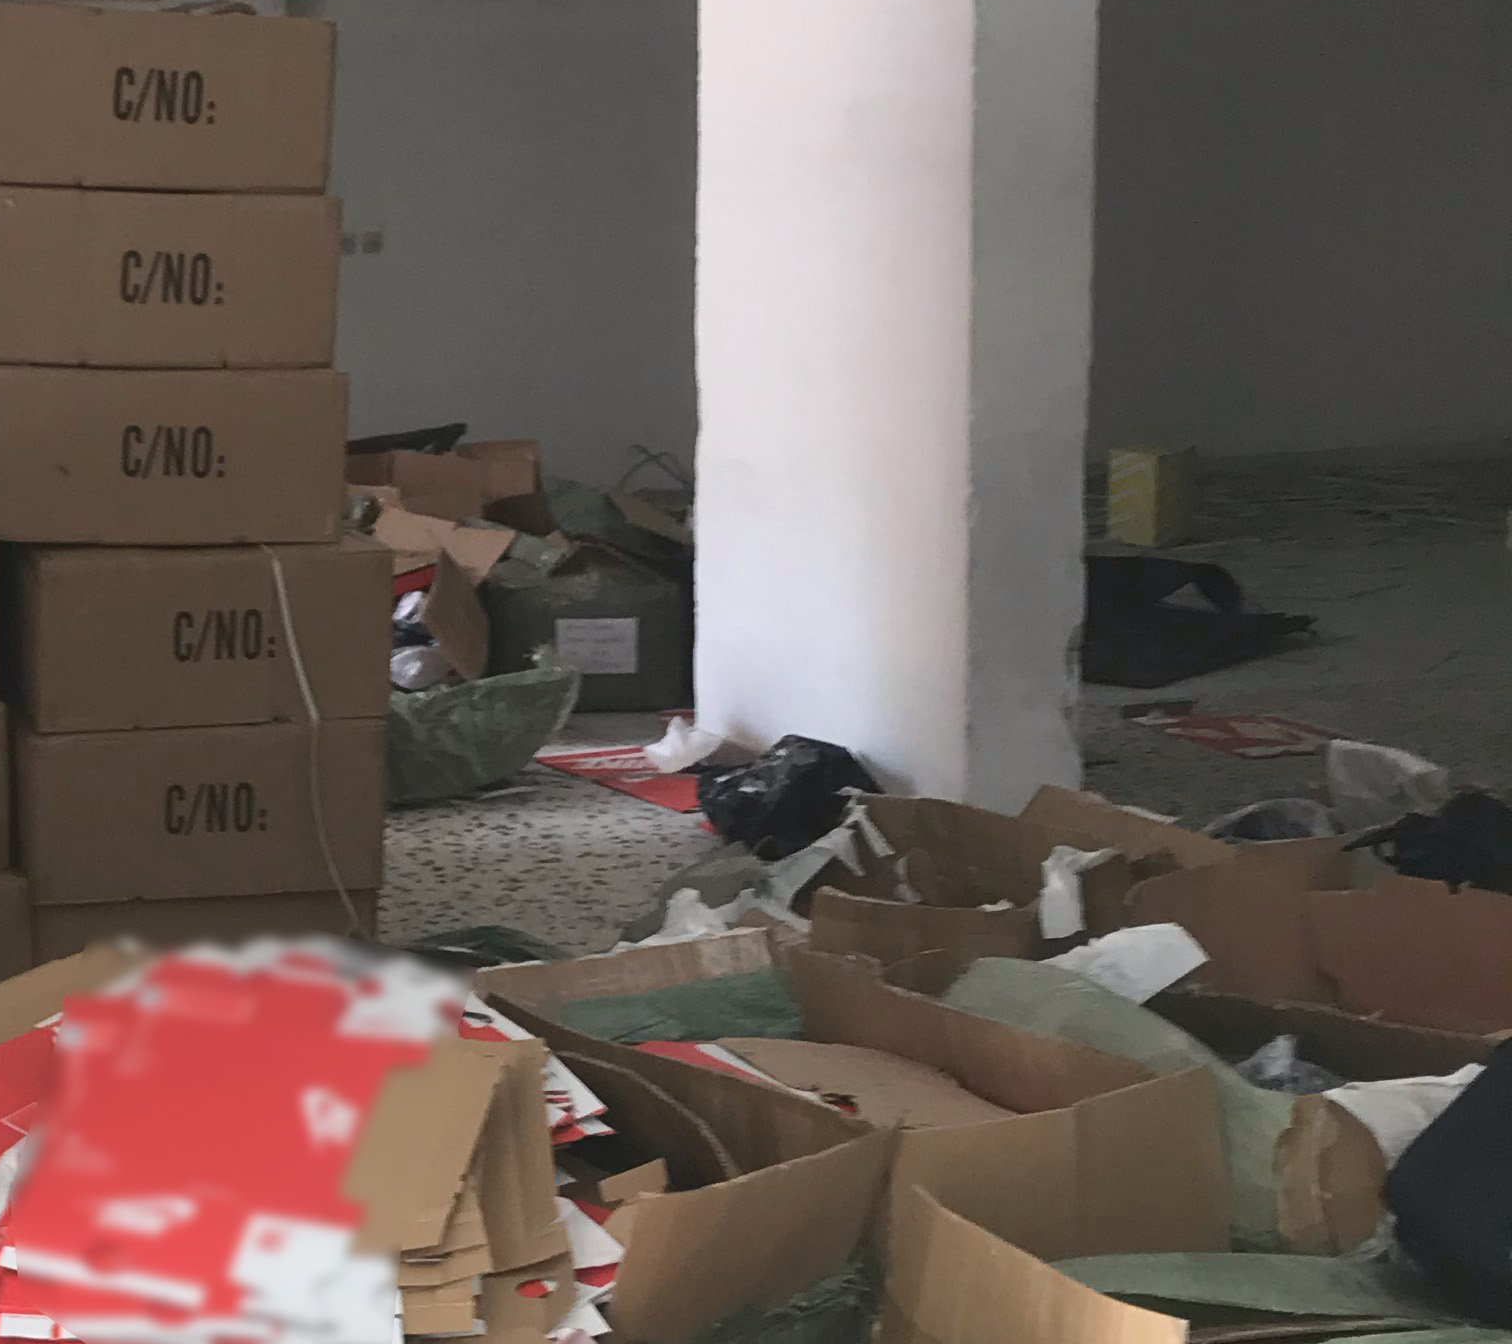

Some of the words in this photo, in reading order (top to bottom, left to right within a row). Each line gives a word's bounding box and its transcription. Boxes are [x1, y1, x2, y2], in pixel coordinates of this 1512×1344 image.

[113, 66, 216, 124] C/NO:
[120, 250, 224, 305] C/NO:
[121, 425, 226, 479] C/NO:
[172, 610, 276, 663] C/NO:
[165, 782, 268, 835] C/NO:
